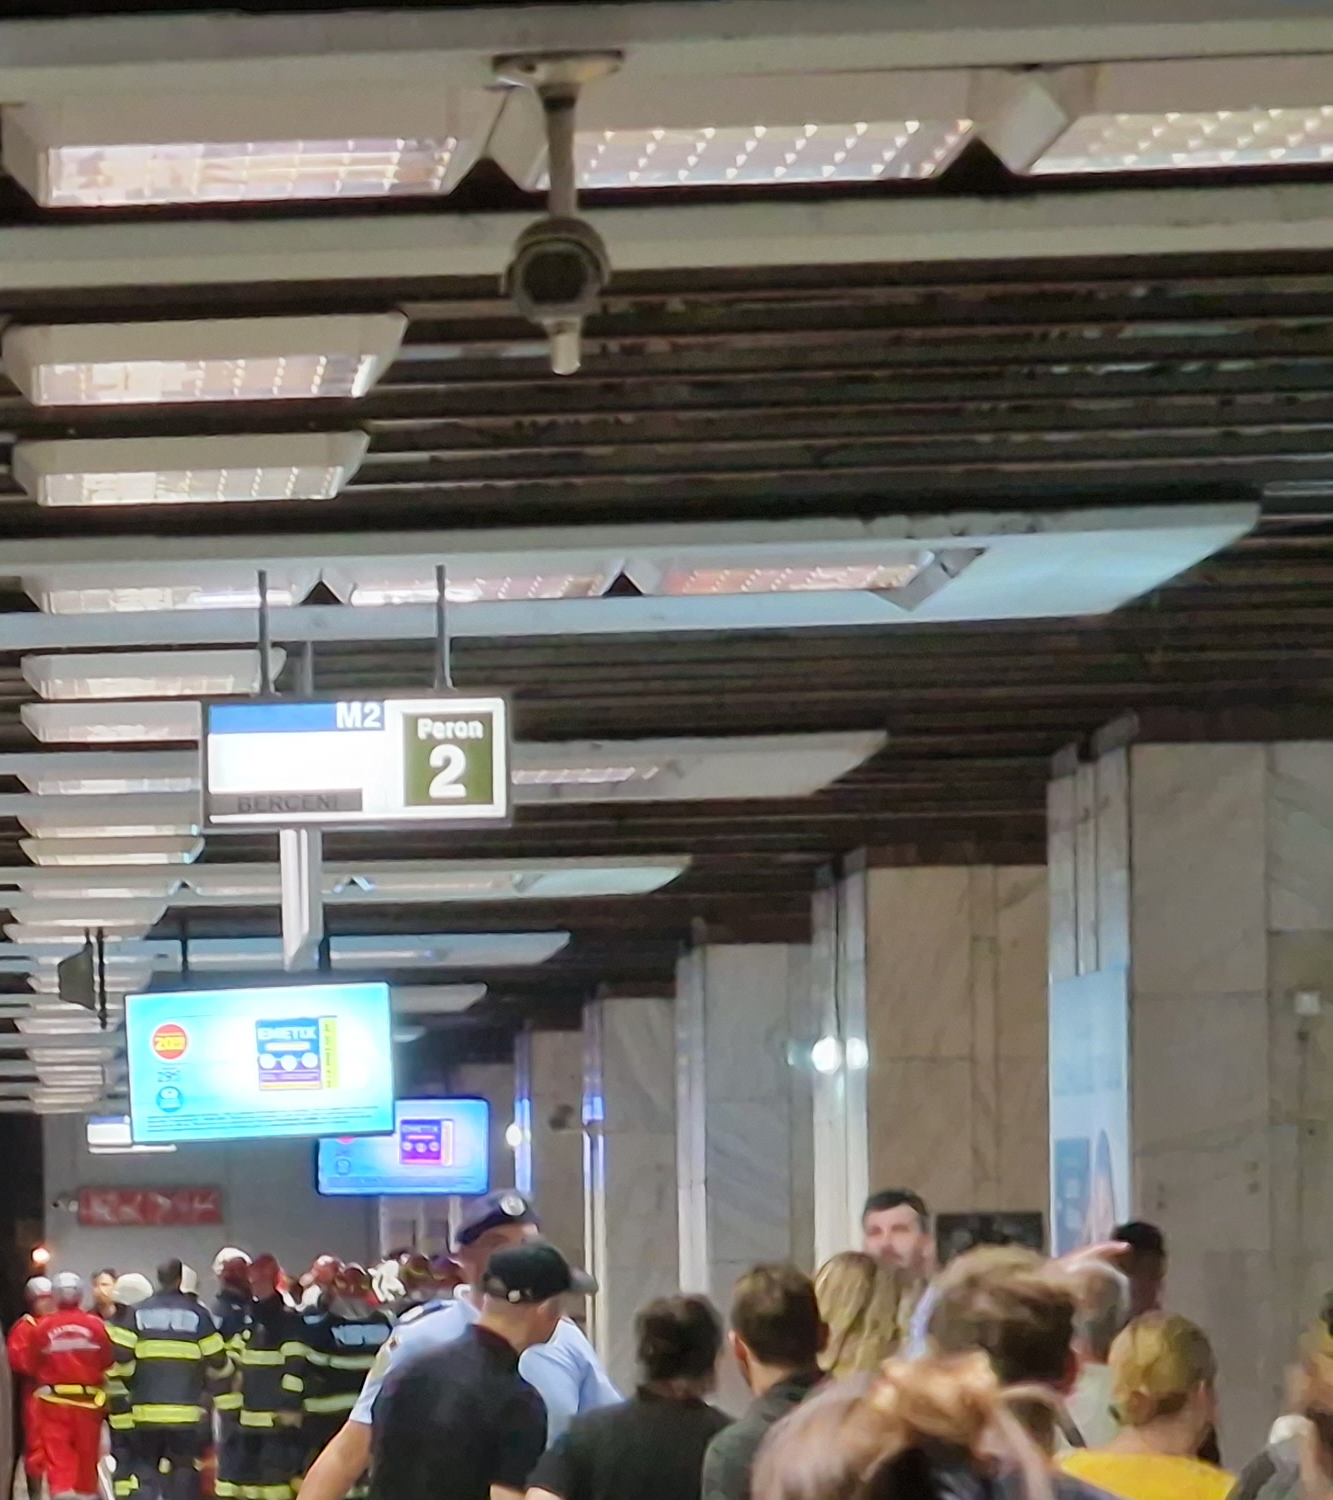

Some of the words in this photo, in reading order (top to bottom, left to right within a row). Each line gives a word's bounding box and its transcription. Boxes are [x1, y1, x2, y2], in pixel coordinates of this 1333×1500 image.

[336, 701, 382, 729] M2
[417, 717, 484, 740] Peron
[429, 743, 466, 798] 2
